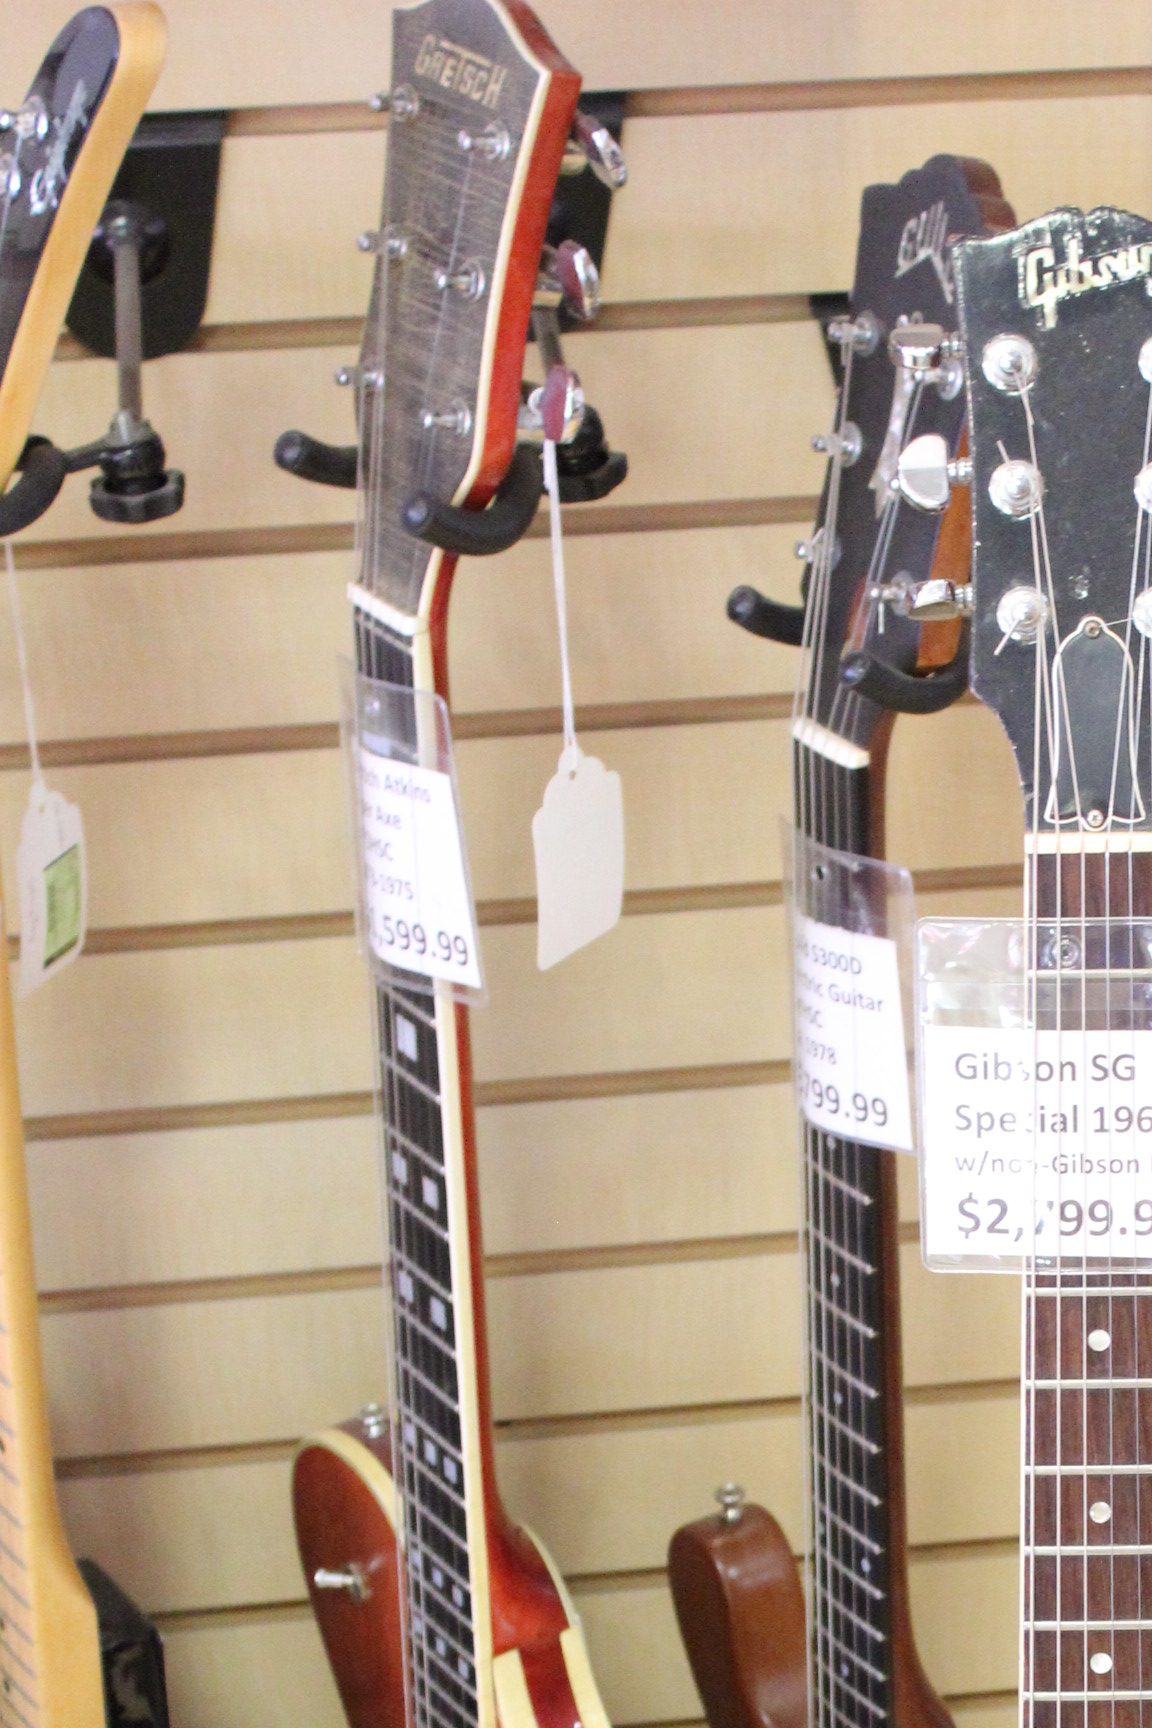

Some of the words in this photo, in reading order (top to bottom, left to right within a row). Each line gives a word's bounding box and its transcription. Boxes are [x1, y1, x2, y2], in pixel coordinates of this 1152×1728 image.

[415, 33, 508, 109] GRETSCH
[384, 774, 432, 803] Atkins
[376, 804, 402, 830] Axe
[811, 944, 862, 976] S300D
[828, 982, 884, 1013] Guitar
[1090, 1053, 1137, 1082] SG
[800, 1068, 889, 1128] 799.99
